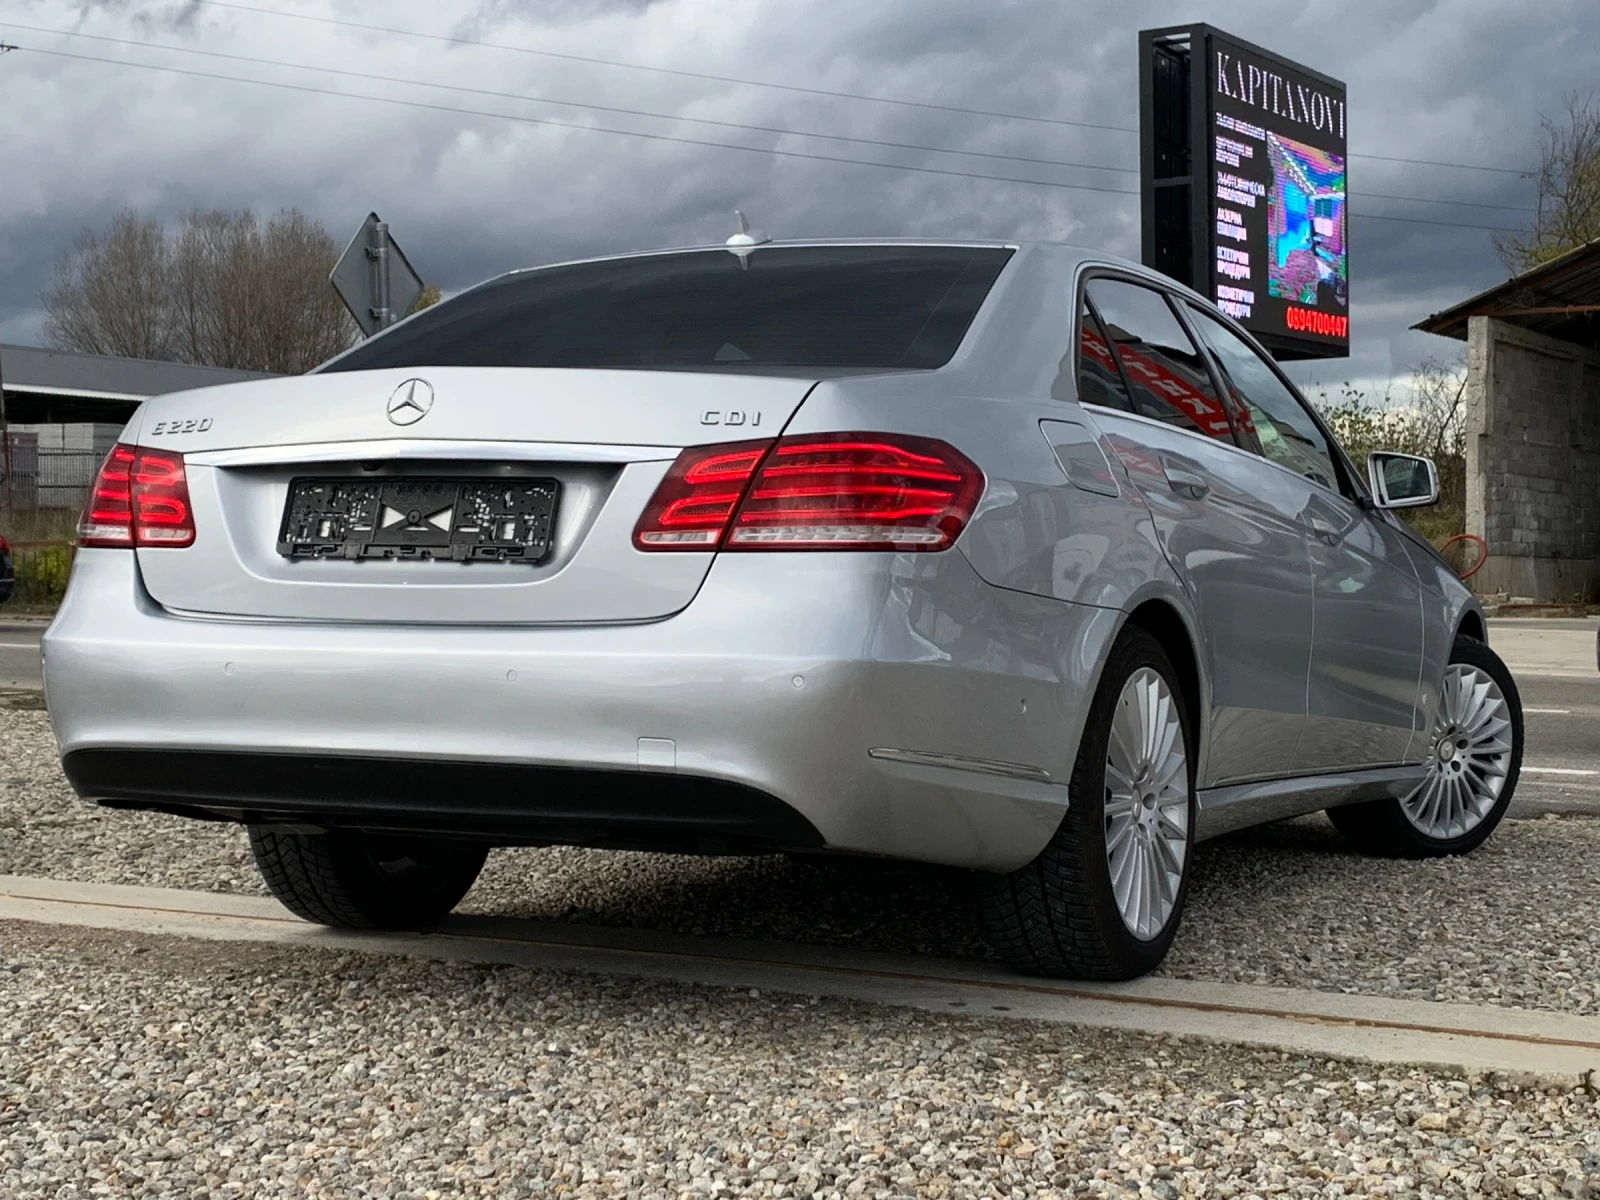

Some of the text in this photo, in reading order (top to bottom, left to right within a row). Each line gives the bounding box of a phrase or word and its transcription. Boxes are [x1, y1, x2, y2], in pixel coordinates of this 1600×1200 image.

[1217, 51, 1344, 138] KAPITANOVI
[151, 417, 214, 436] E220
[700, 409, 762, 427] CDI
